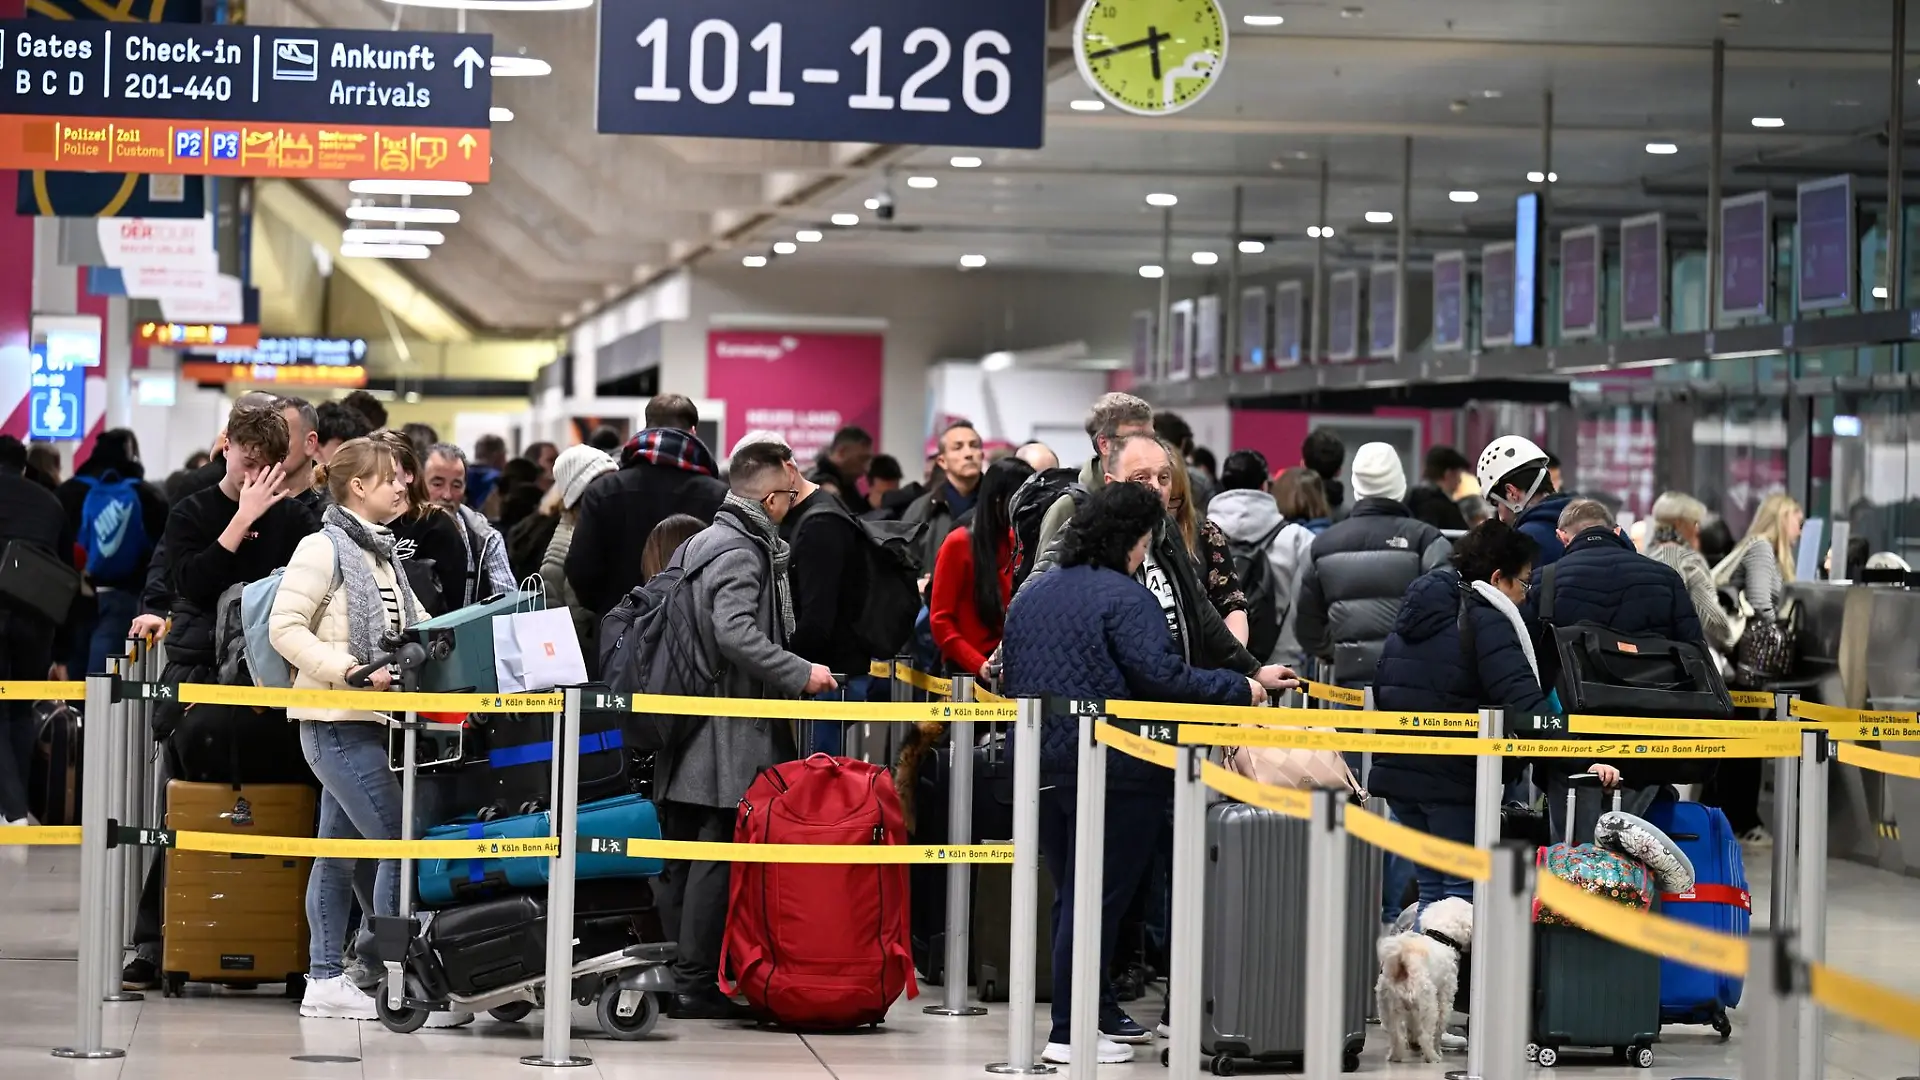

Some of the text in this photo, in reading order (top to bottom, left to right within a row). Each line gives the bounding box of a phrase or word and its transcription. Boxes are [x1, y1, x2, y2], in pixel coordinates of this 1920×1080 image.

[16, 31, 92, 59] Gates
[125, 35, 241, 64] Check-in
[330, 42, 436, 71] Ankunft
[634, 17, 1012, 115] 101-126
[16, 69, 84, 96] B C D
[124, 73, 231, 101] 201-440
[329, 79, 431, 108] Arrivals
[63, 127, 107, 142] Polizei
[115, 128, 142, 143] Zoll
[63, 142, 99, 156] Police
[115, 143, 166, 158] Customs
[176, 132, 201, 157] P2
[213, 133, 238, 158] P3
[505, 697, 523, 707] Köln
[526, 698, 546, 706] Bonn
[954, 707, 972, 716] Köln
[975, 708, 994, 716] Bonn
[1423, 717, 1441, 727] Köln
[1443, 718, 1462, 727] Bonn
[1882, 727, 1900, 736] Köln
[1517, 744, 1593, 754] Köln Bonn Airport
[1651, 744, 1726, 754] Köln Bonn Airport
[501, 843, 520, 852] Köln
[522, 843, 542, 851] Bonn
[948, 849, 966, 858] Köln
[969, 849, 988, 858] Bonn
